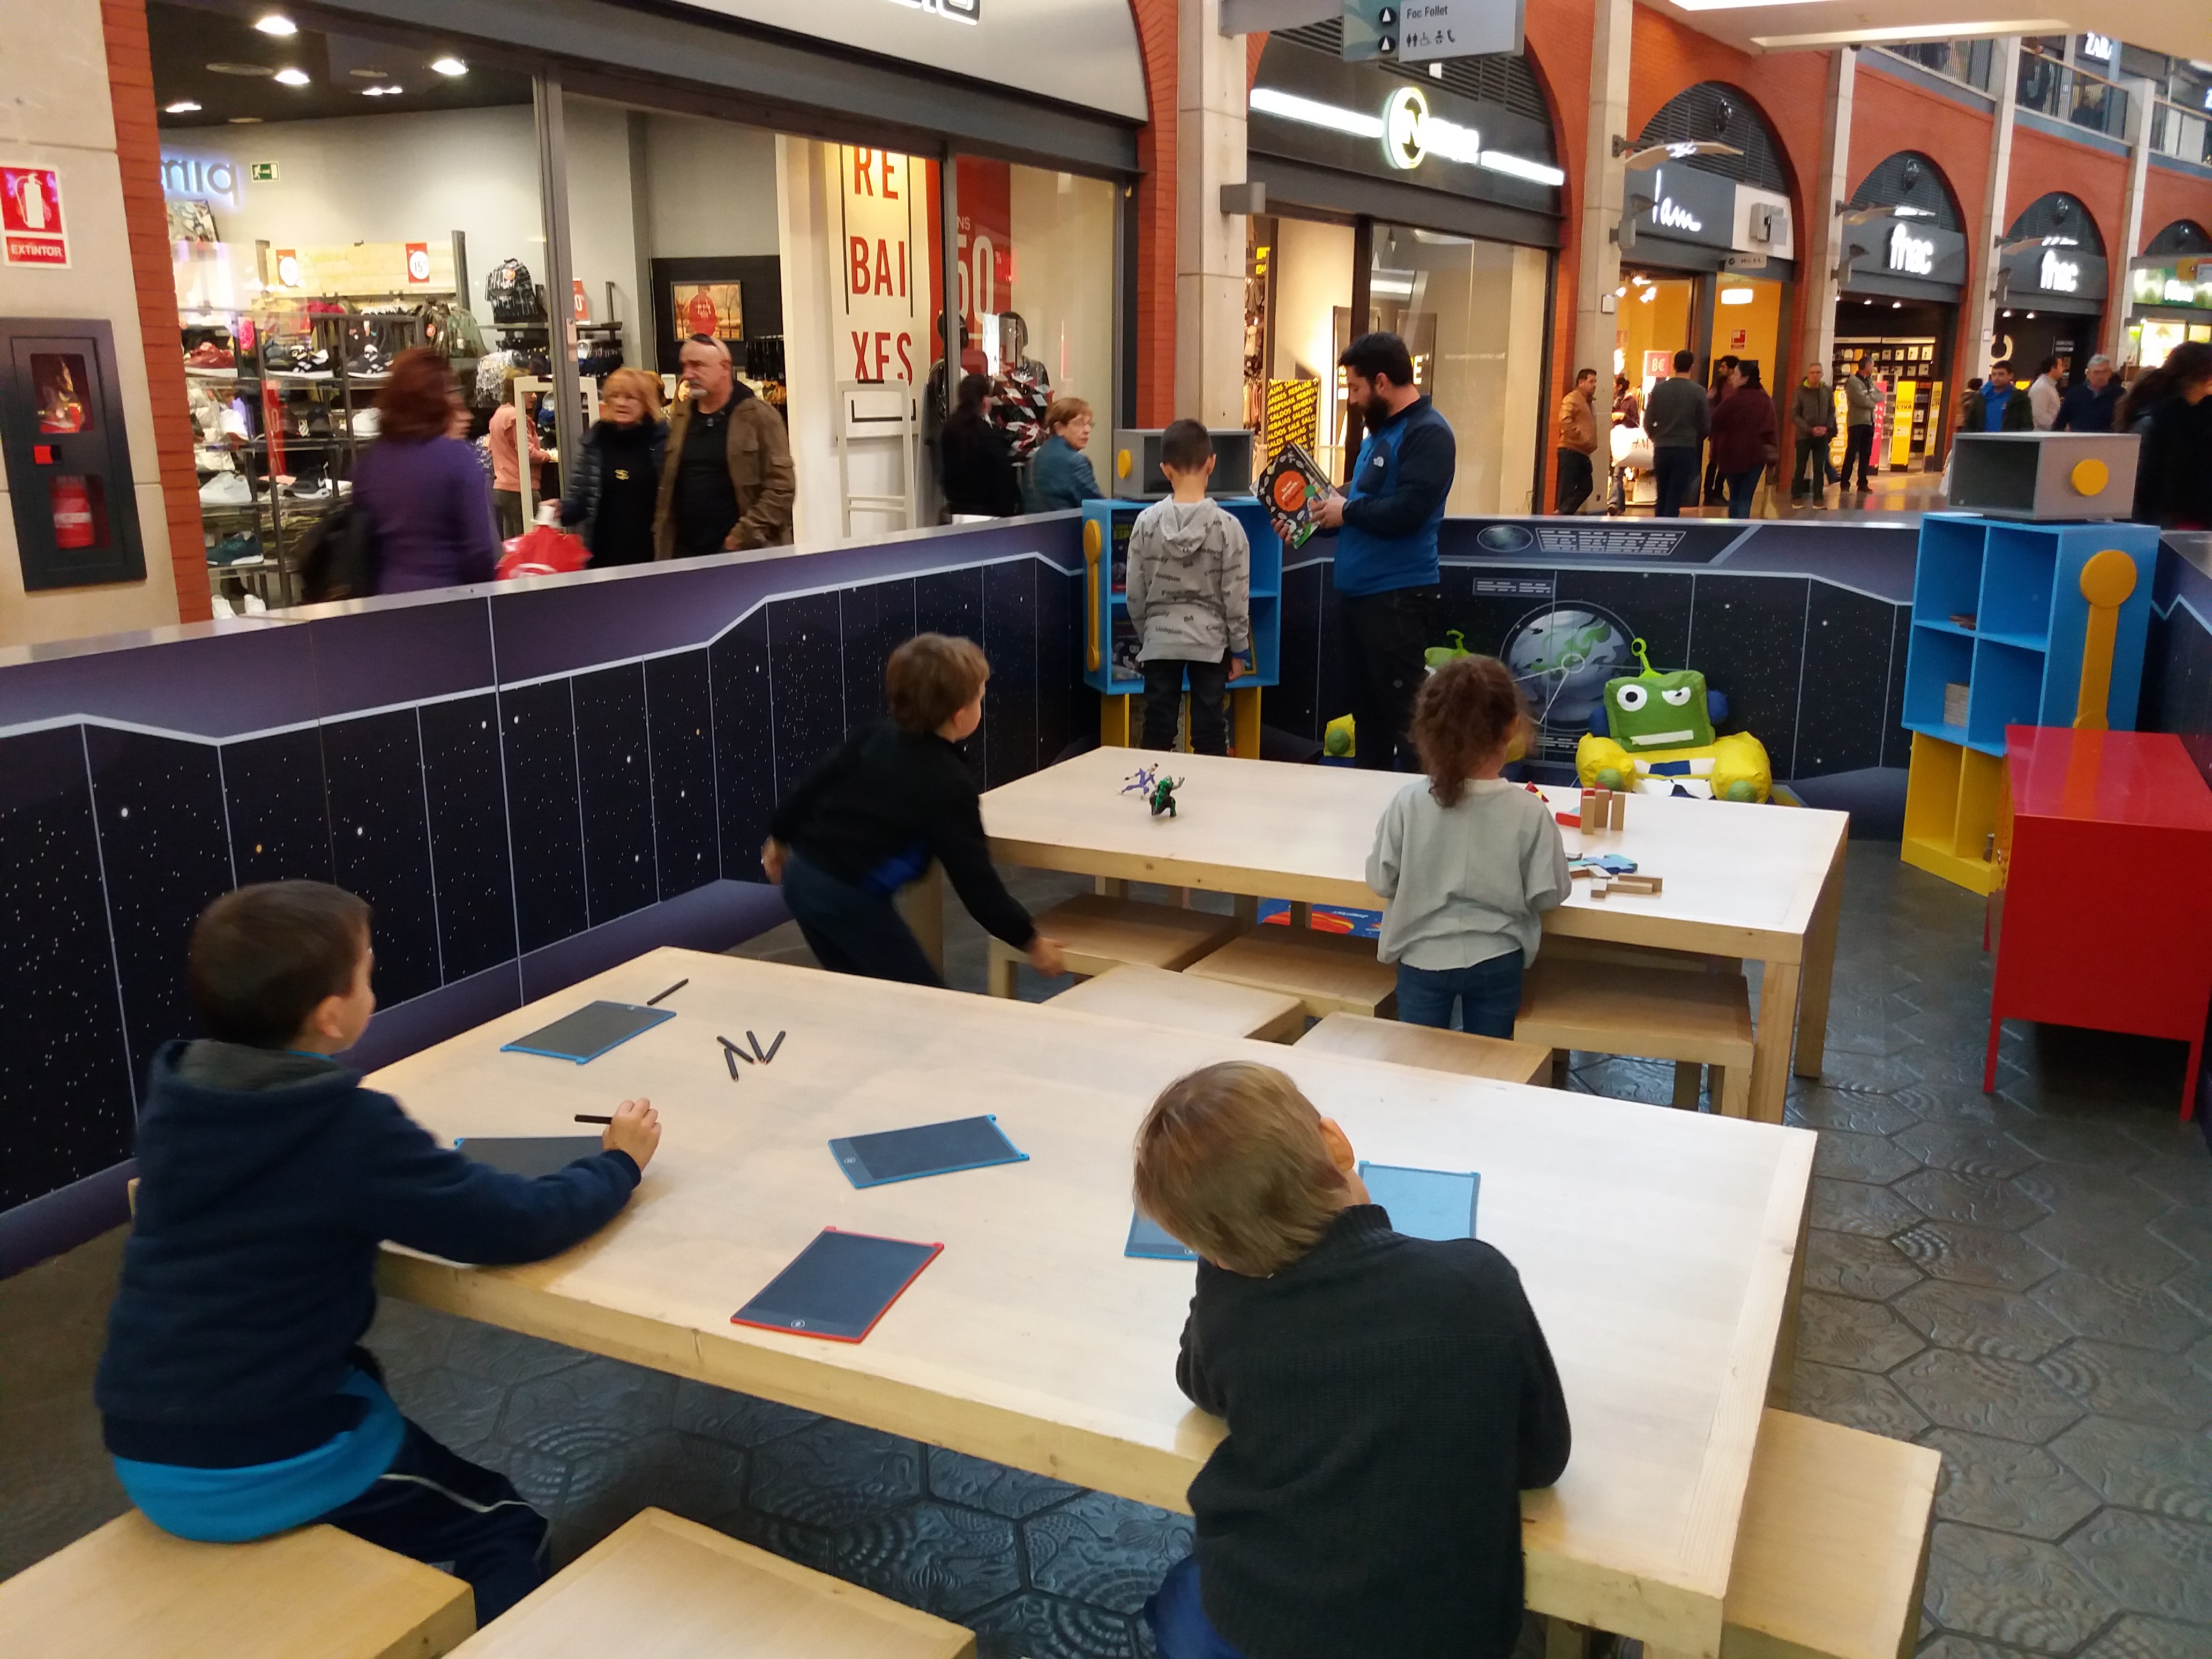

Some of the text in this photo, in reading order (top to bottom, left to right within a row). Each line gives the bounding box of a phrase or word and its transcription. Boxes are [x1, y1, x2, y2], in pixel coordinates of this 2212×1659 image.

[1407, 8, 1422, 19] Foc
[854, 145, 898, 200] RE
[11, 244, 63, 257] EXTINTOR
[1890, 223, 1933, 275] fnac
[850, 236, 906, 297] BAI
[1651, 357, 1665, 372] 8€
